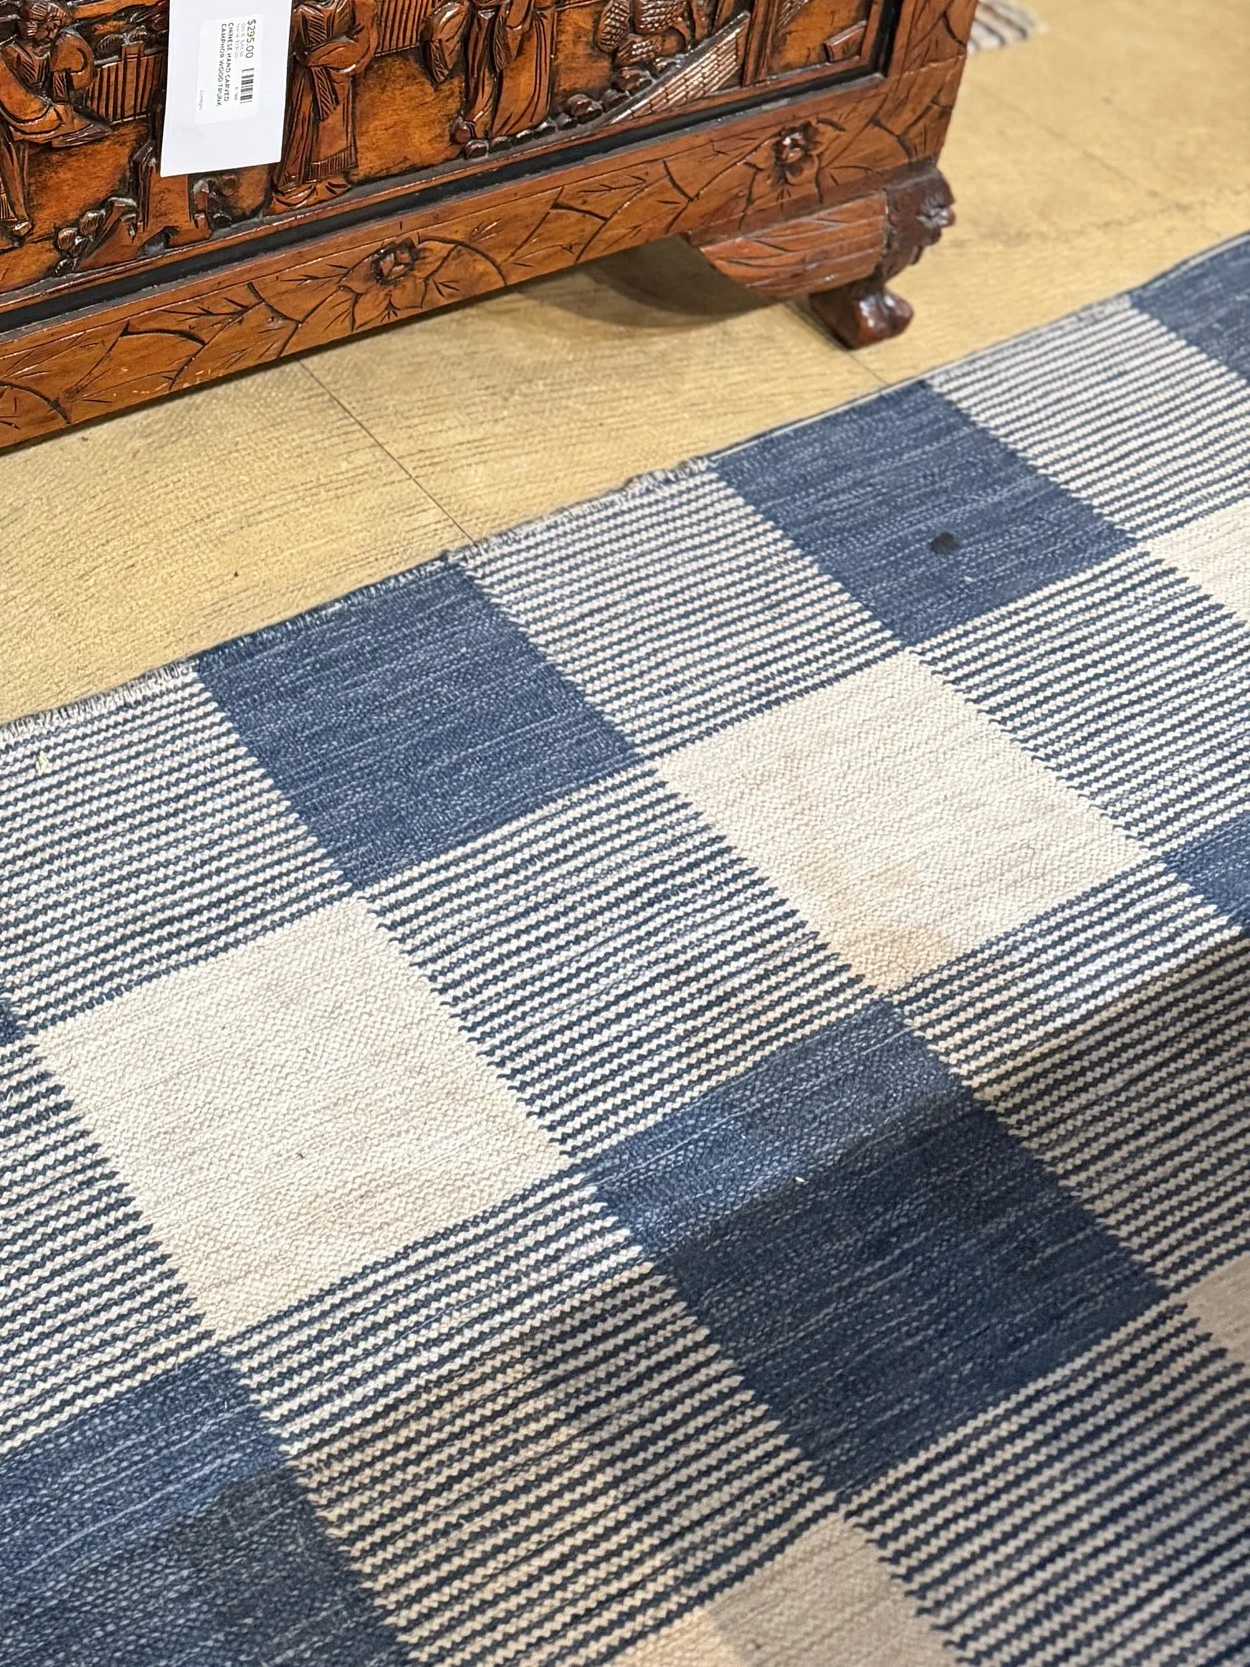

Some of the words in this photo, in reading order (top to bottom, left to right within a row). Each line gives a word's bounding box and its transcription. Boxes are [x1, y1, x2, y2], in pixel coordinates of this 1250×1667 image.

[219, 23, 227, 58] CAMPHOR
[226, 22, 234, 51] CHINESE
[245, 18, 257, 59] $295.00
[217, 59, 225, 83] WOOD
[223, 74, 231, 102] CARVED
